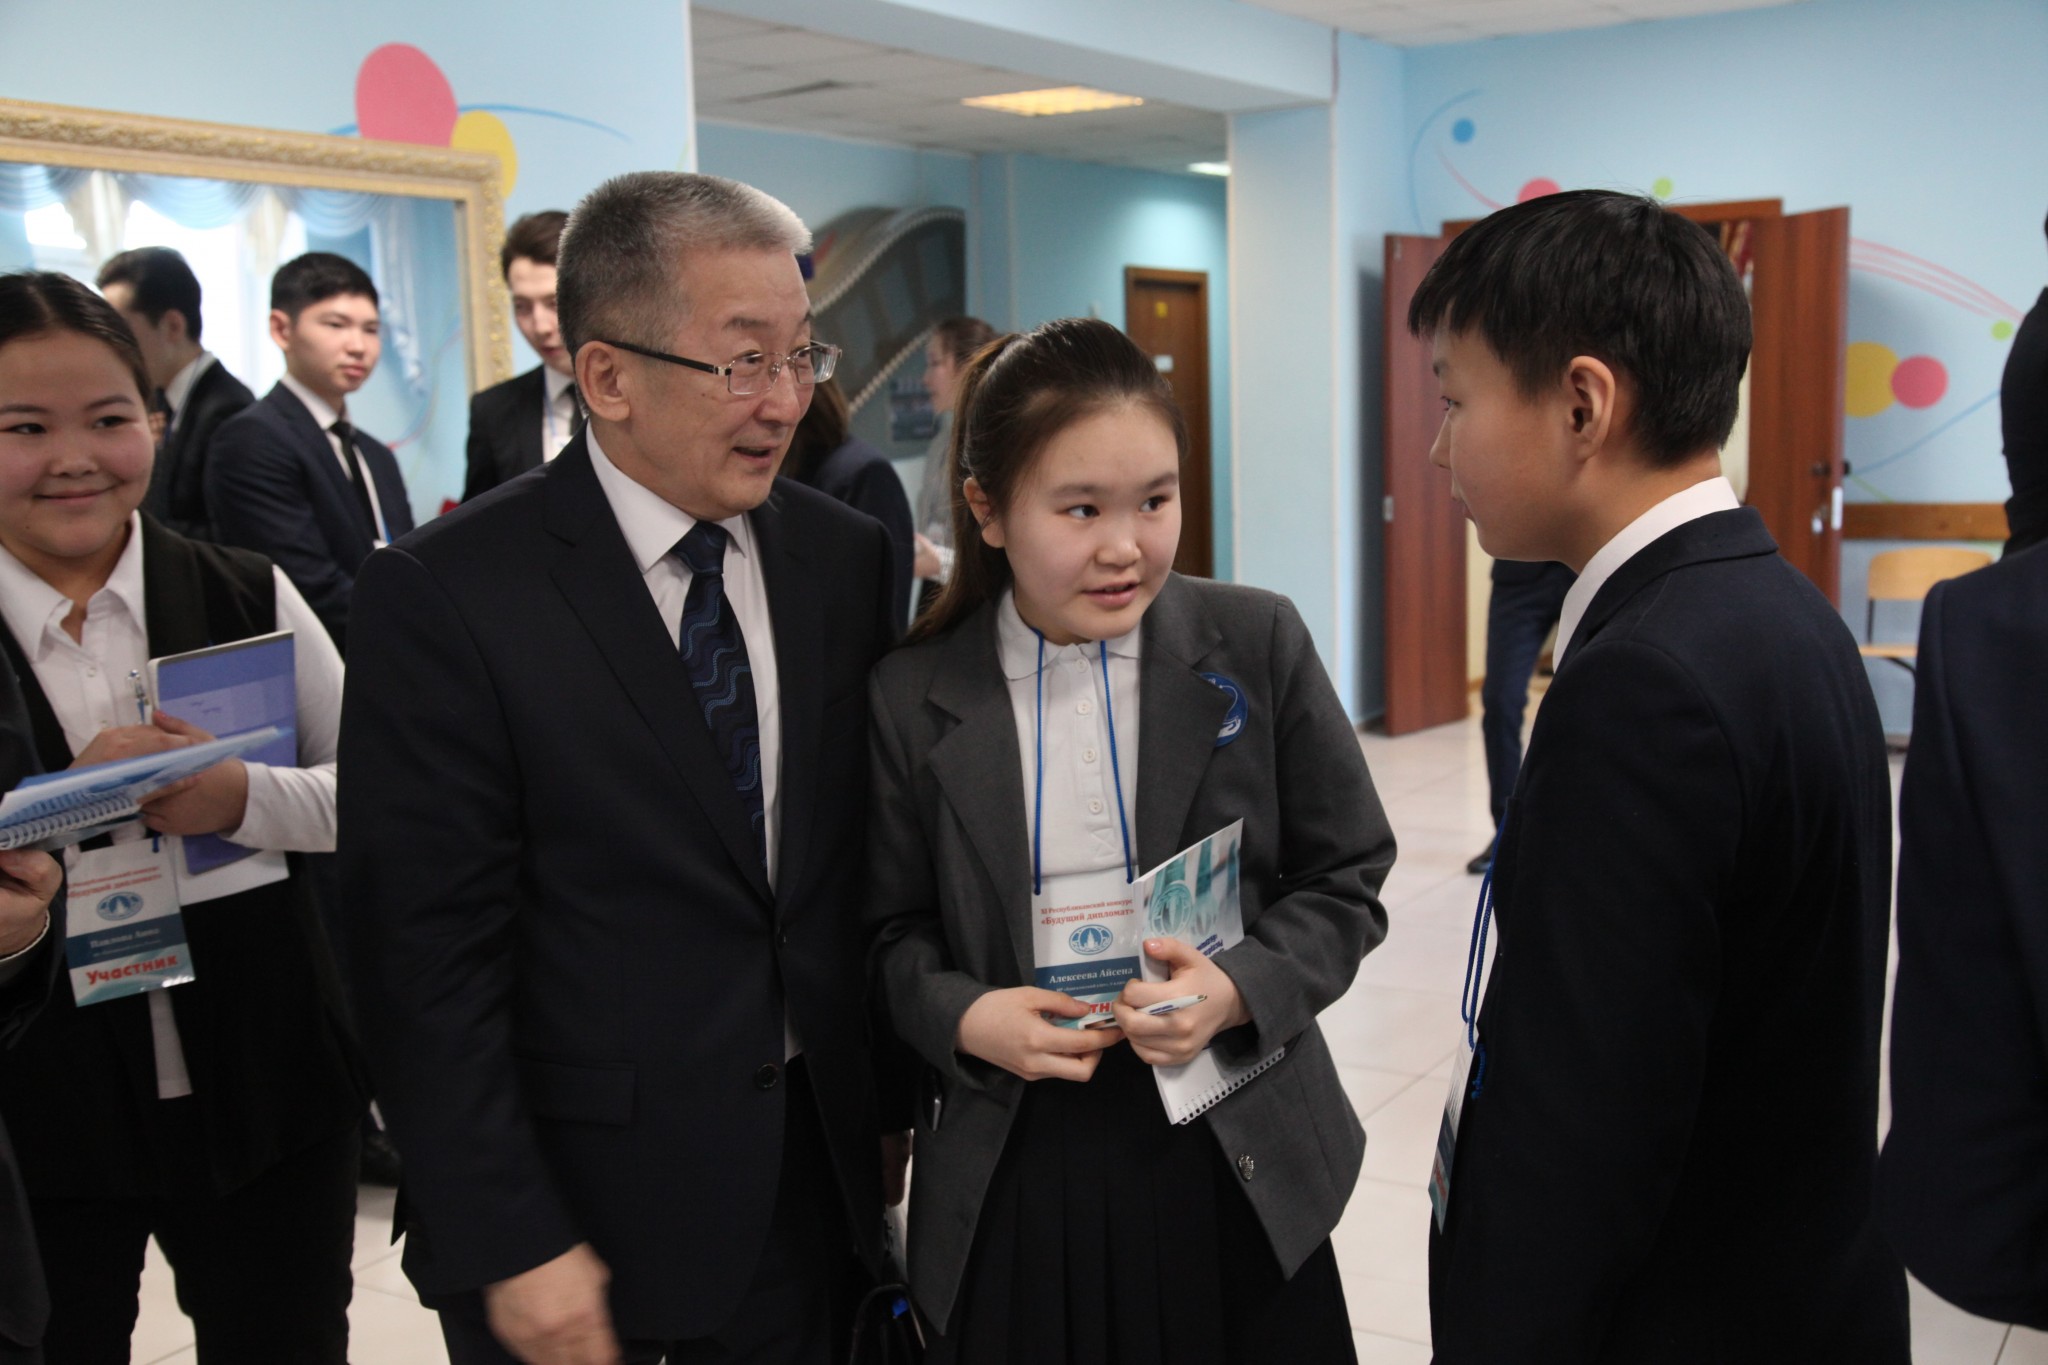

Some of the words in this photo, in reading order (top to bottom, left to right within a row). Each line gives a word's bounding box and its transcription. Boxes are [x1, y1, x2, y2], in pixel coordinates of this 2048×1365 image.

[1041, 912, 1085, 925] «Будущий
[1087, 909, 1135, 920] дипломат»
[1049, 971, 1097, 984] Алексеева
[1099, 967, 1133, 978] Айсена
